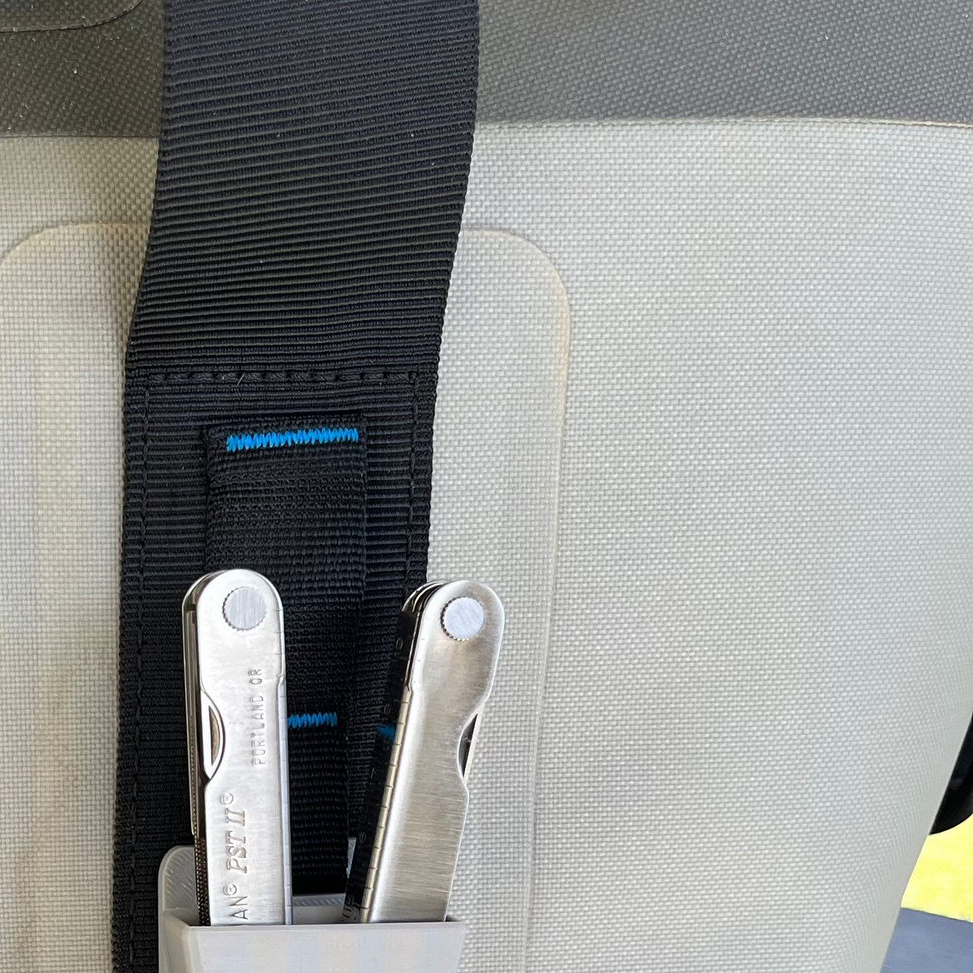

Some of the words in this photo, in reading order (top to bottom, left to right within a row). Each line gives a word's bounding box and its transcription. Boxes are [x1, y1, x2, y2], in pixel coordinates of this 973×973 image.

[247, 668, 263, 686] OR
[250, 694, 266, 767] PORTLAND
[225, 830, 248, 874] PST
